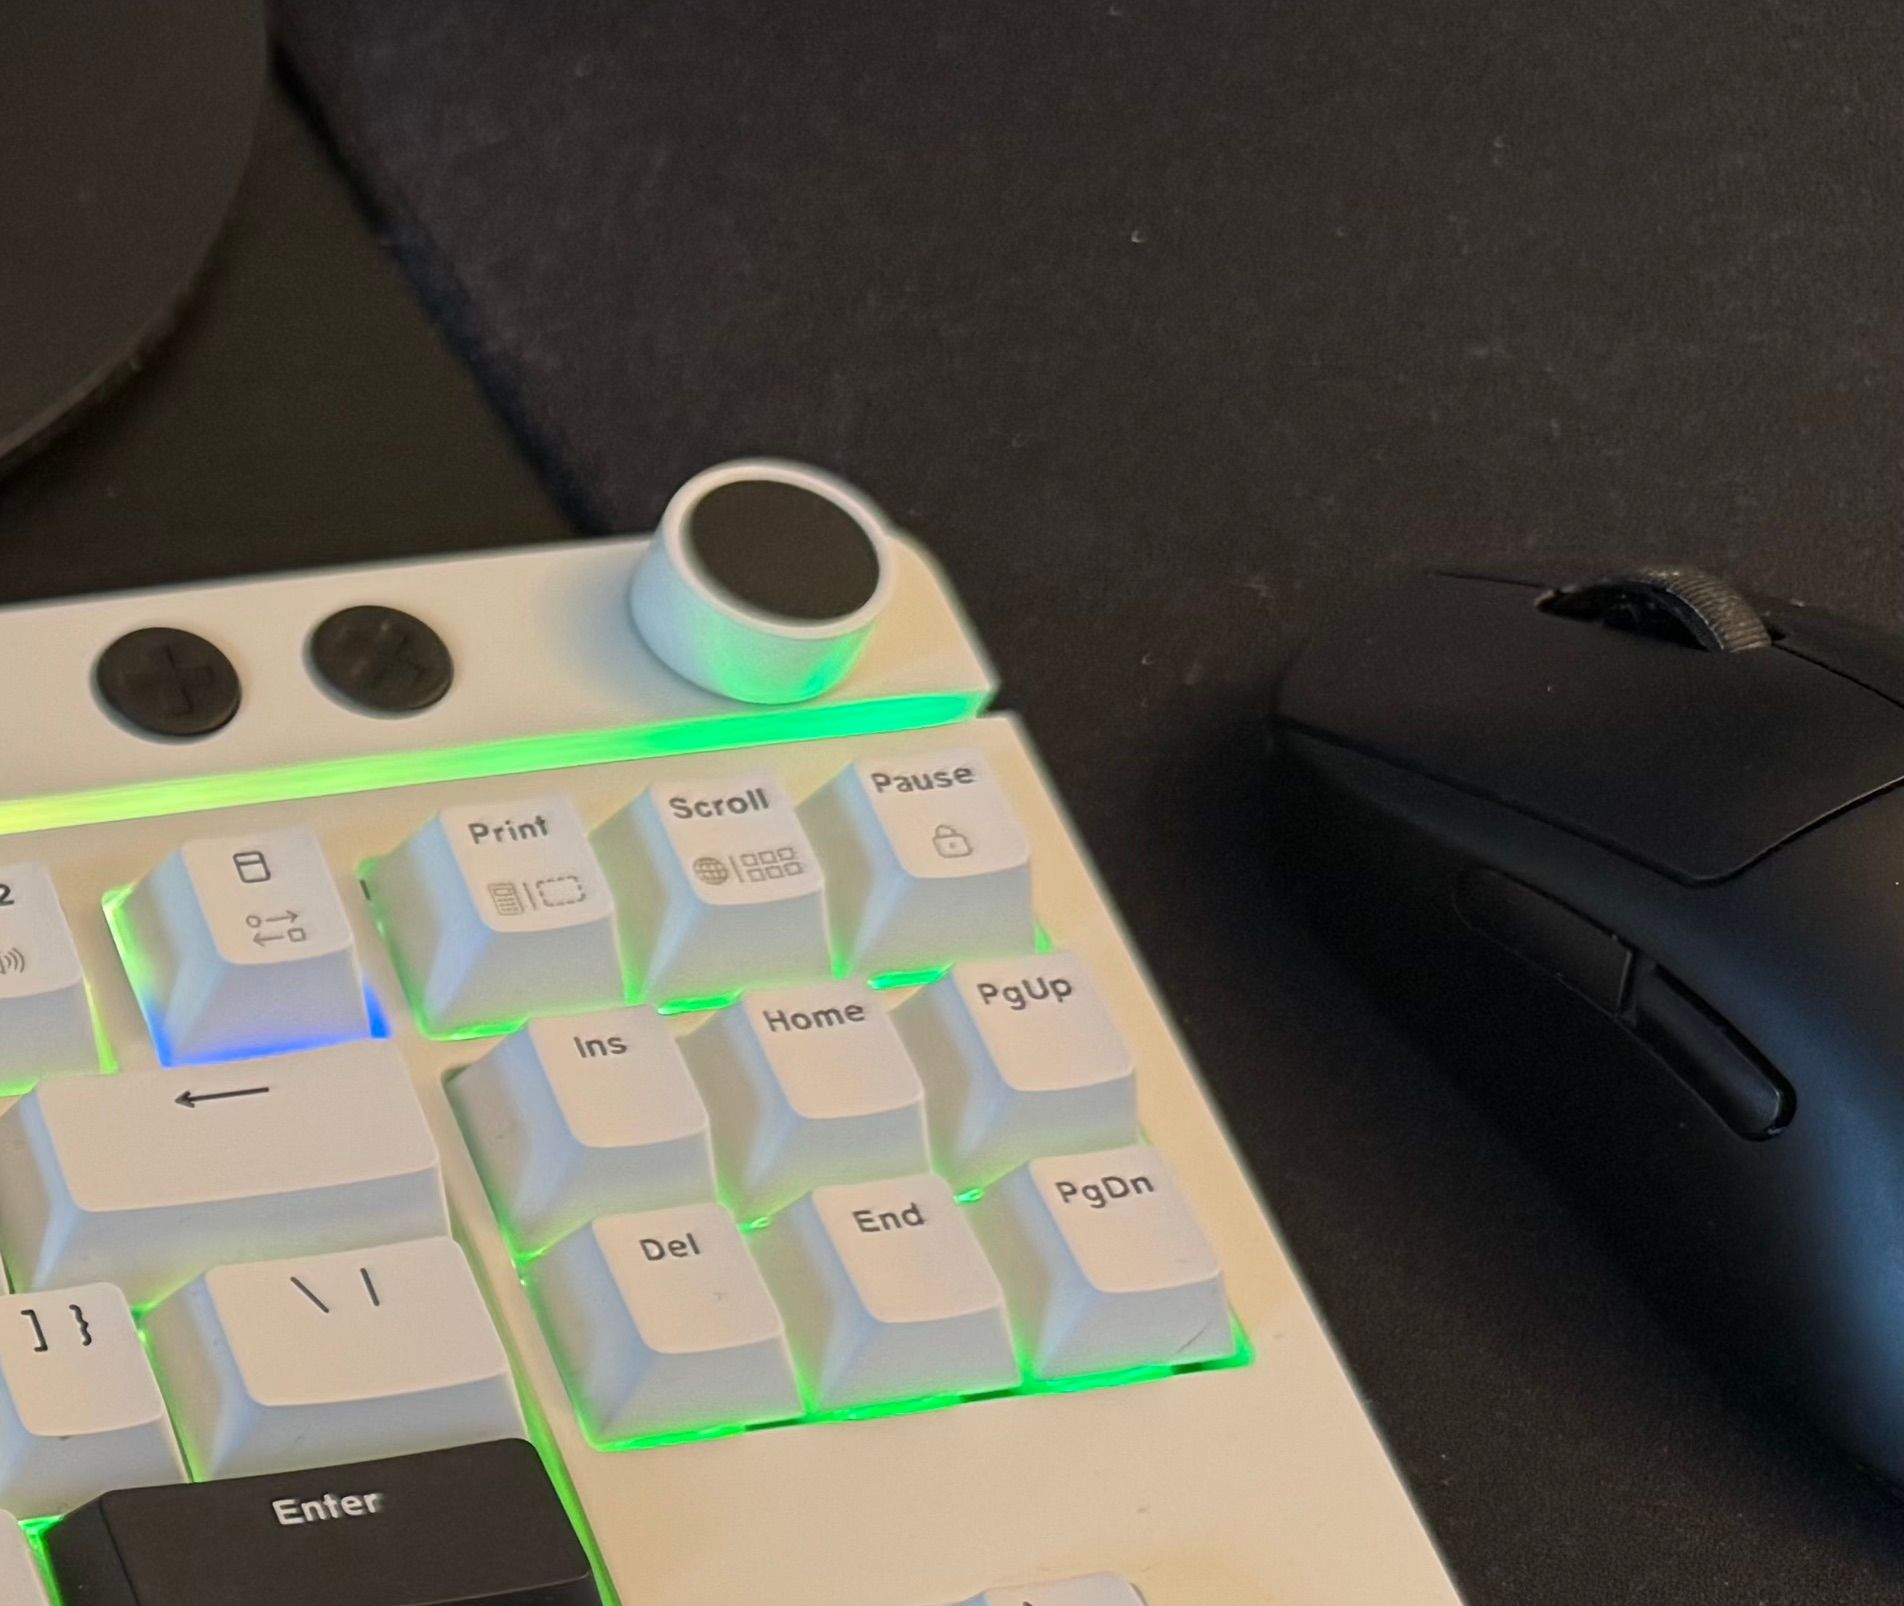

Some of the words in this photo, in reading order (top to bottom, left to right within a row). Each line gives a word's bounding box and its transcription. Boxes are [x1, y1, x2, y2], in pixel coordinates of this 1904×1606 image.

[870, 766, 974, 794] Pause
[668, 787, 770, 820] Scroll
[467, 814, 549, 845] Print
[976, 976, 1074, 1011] PgUp
[762, 1003, 866, 1032] Home
[573, 1036, 629, 1059] Ins
[1055, 1175, 1155, 1210] PgDn
[851, 1202, 927, 1233] End
[639, 1232, 701, 1262] Del
[272, 1492, 381, 1526] Enter
